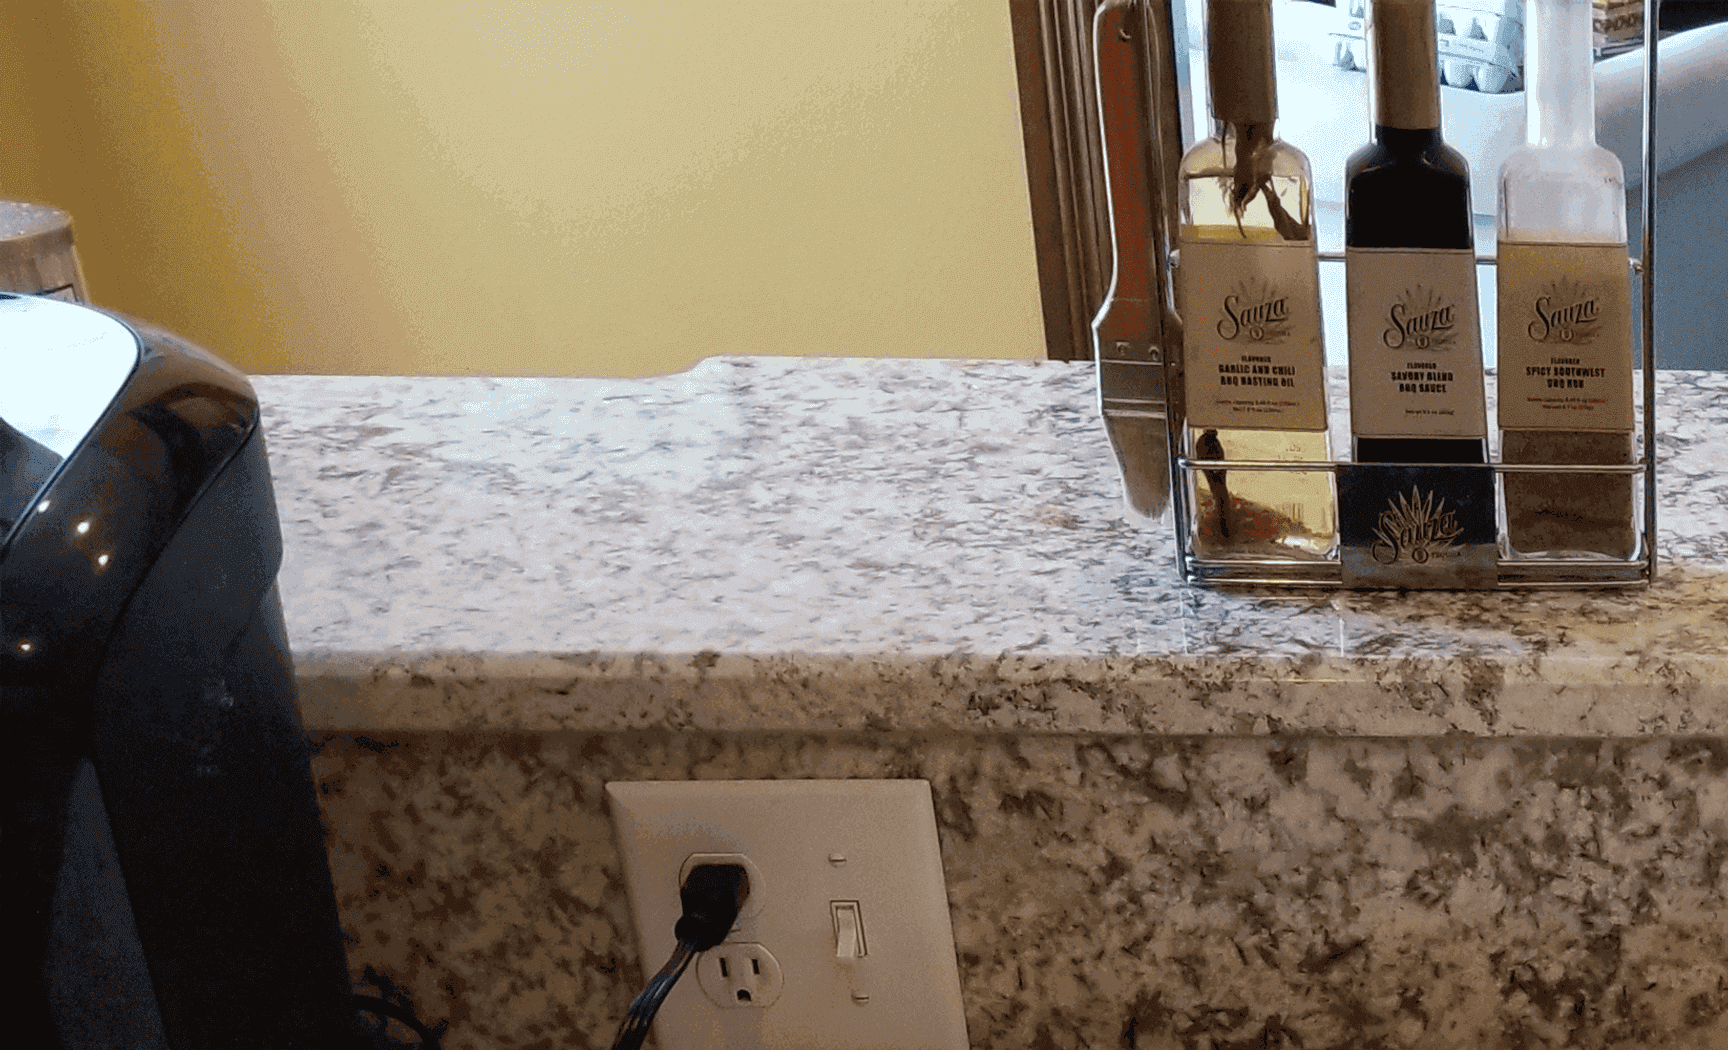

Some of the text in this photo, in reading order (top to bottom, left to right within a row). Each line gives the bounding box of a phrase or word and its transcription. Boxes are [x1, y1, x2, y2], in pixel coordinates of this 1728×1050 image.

[1217, 295, 1290, 340] Sauza
[1528, 297, 1600, 343] Sauza
[1383, 304, 1455, 349] Sauza
[1218, 364, 1296, 376] GARLIC AND CHILI
[1526, 366, 1605, 378] SPICY SOUTHWEST
[1220, 376, 1295, 388] BBQ BASTING OIL
[1391, 371, 1454, 382] SAVORY BLEND
[1399, 383, 1447, 393] BBQ SAUCE
[1547, 378, 1565, 389] BBQ
[1372, 510, 1460, 565] Sauza
